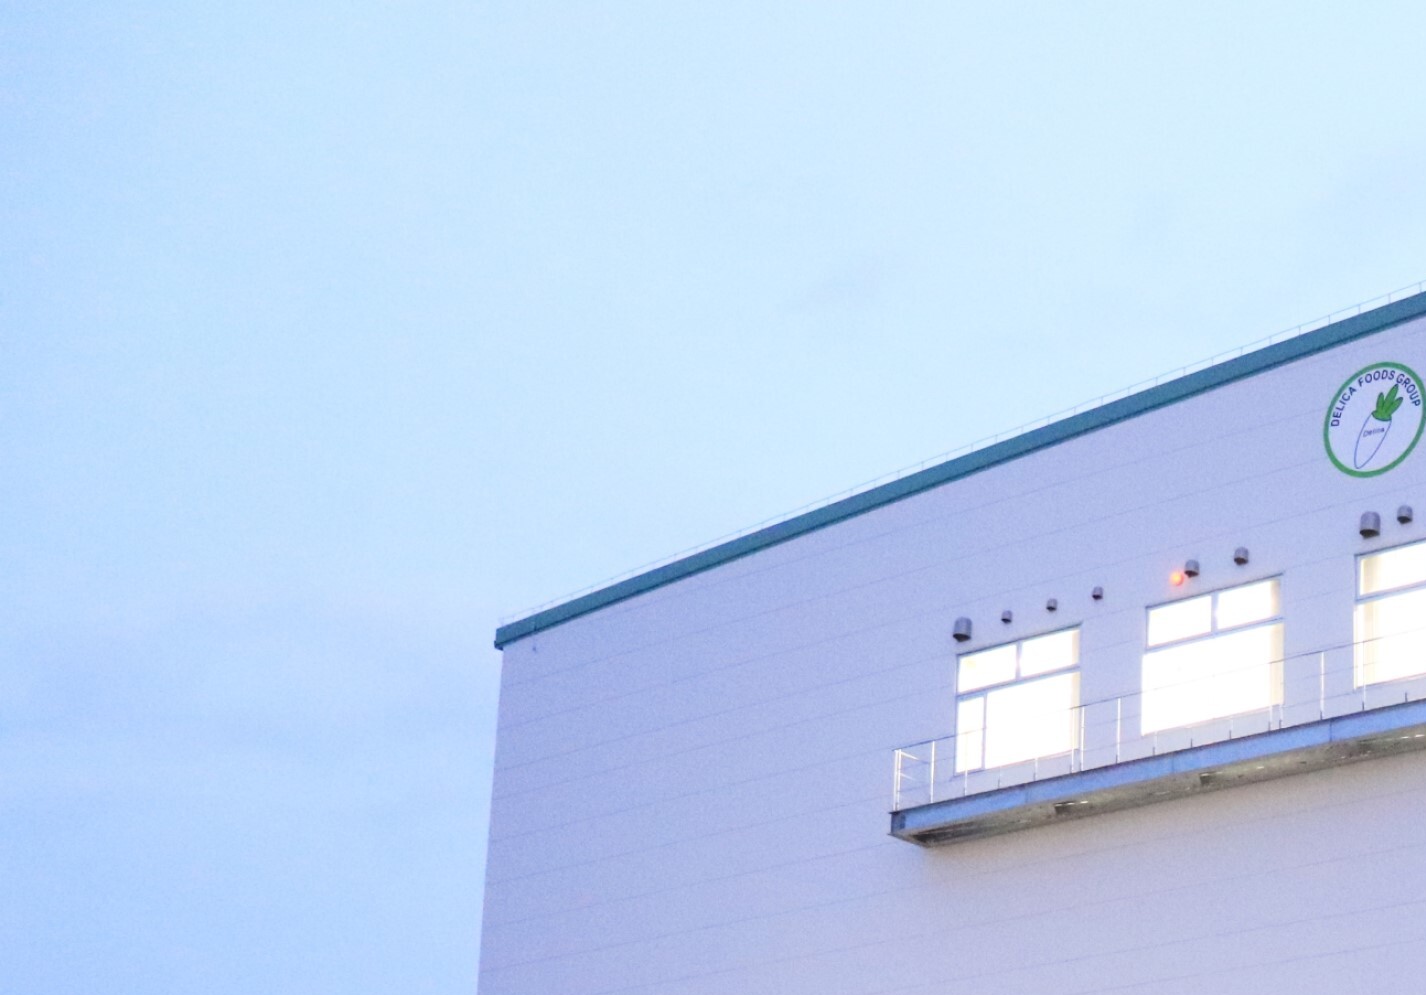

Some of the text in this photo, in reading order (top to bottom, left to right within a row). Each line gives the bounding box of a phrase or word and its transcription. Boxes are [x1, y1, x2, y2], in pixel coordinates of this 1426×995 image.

[1331, 369, 1421, 427] DELICA FOODS GROUP
